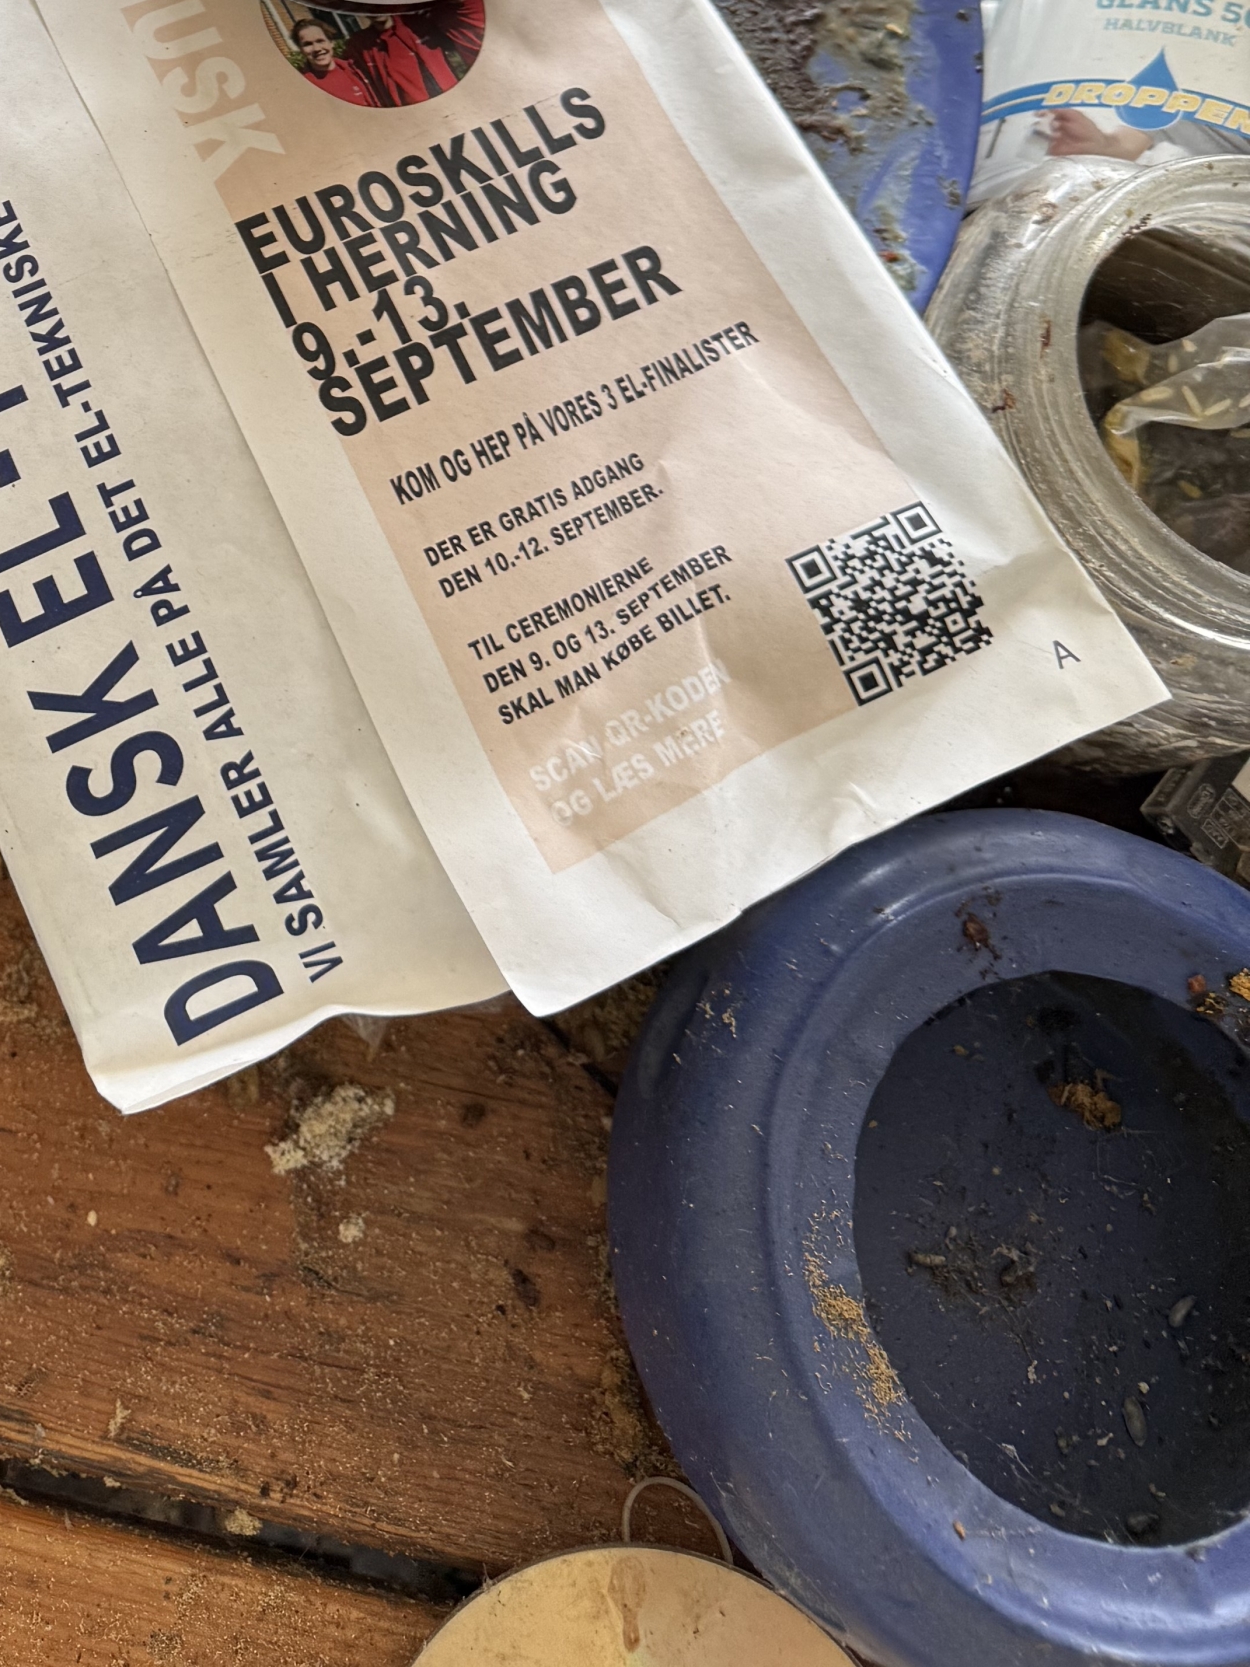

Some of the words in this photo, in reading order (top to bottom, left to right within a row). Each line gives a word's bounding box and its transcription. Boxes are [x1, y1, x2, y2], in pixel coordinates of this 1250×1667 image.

[1103, 17, 1237, 47] HALVBLANK
[234, 86, 607, 274] EUROSKILLS
[261, 271, 297, 329] I
[299, 158, 579, 312] HERNING
[318, 244, 683, 437] SEPTEMBER
[389, 461, 441, 505] KOM
[439, 447, 472, 483] OG
[469, 429, 511, 468] HEP
[512, 411, 544, 450] PÅ
[539, 390, 603, 436] VORES
[600, 383, 618, 410] 3
[615, 320, 760, 404] EL-FINALISTER
[96, 478, 163, 562] DET
[423, 533, 467, 567] DER
[466, 519, 498, 547] ER
[498, 487, 568, 533] GRATIS
[570, 452, 645, 501] ADGANG
[438, 564, 483, 599] DEN
[484, 537, 549, 577] 10.-12.
[550, 482, 664, 547] SEPTEMBER.
[133, 564, 190, 627] PÅ
[467, 633, 505, 661] TIL
[505, 556, 654, 644] CEREMONIERNE
[482, 659, 528, 694] DEN
[529, 651, 551, 672] 9.
[552, 633, 582, 661] OG
[585, 619, 615, 644] 13.
[615, 544, 733, 626] SEPTEMBER
[498, 687, 554, 725] SKAL
[554, 662, 602, 699] MAN
[601, 624, 658, 671] KØBE
[655, 583, 732, 633] BILLET.
[1052, 639, 1081, 669] A
[165, 630, 245, 742] ALLE
[529, 736, 603, 792] SCAN
[603, 658, 732, 746] QR-KODEN
[550, 789, 593, 826] OG
[593, 752, 655, 802] LÆS
[653, 709, 726, 767] MERE
[26, 639, 285, 1047] DANSK
[220, 749, 324, 937] SAMLER
[298, 940, 344, 984] VI
